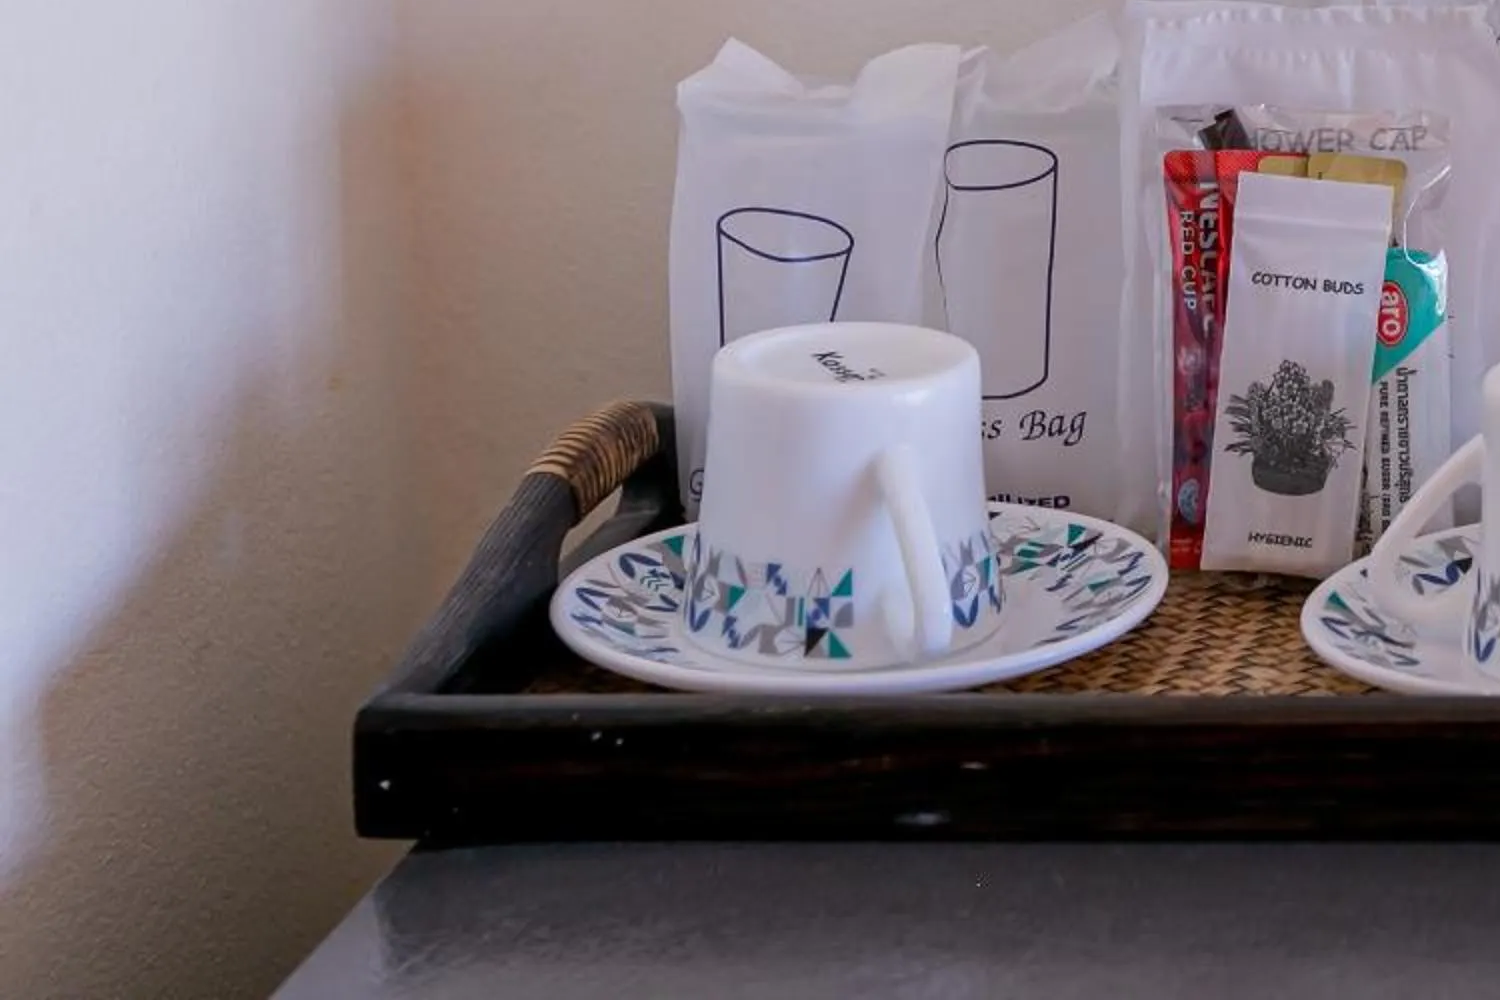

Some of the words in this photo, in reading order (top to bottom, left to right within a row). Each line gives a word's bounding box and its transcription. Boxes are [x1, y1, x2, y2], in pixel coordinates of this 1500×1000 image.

[1369, 125, 1428, 151] CAP
[1179, 209, 1196, 255] RED
[1180, 264, 1198, 311] CUP
[1251, 271, 1317, 291] COTTON
[1322, 279, 1365, 295] BUDS
[1019, 409, 1088, 447] Bag
[1248, 530, 1313, 548] HYGIENIC
